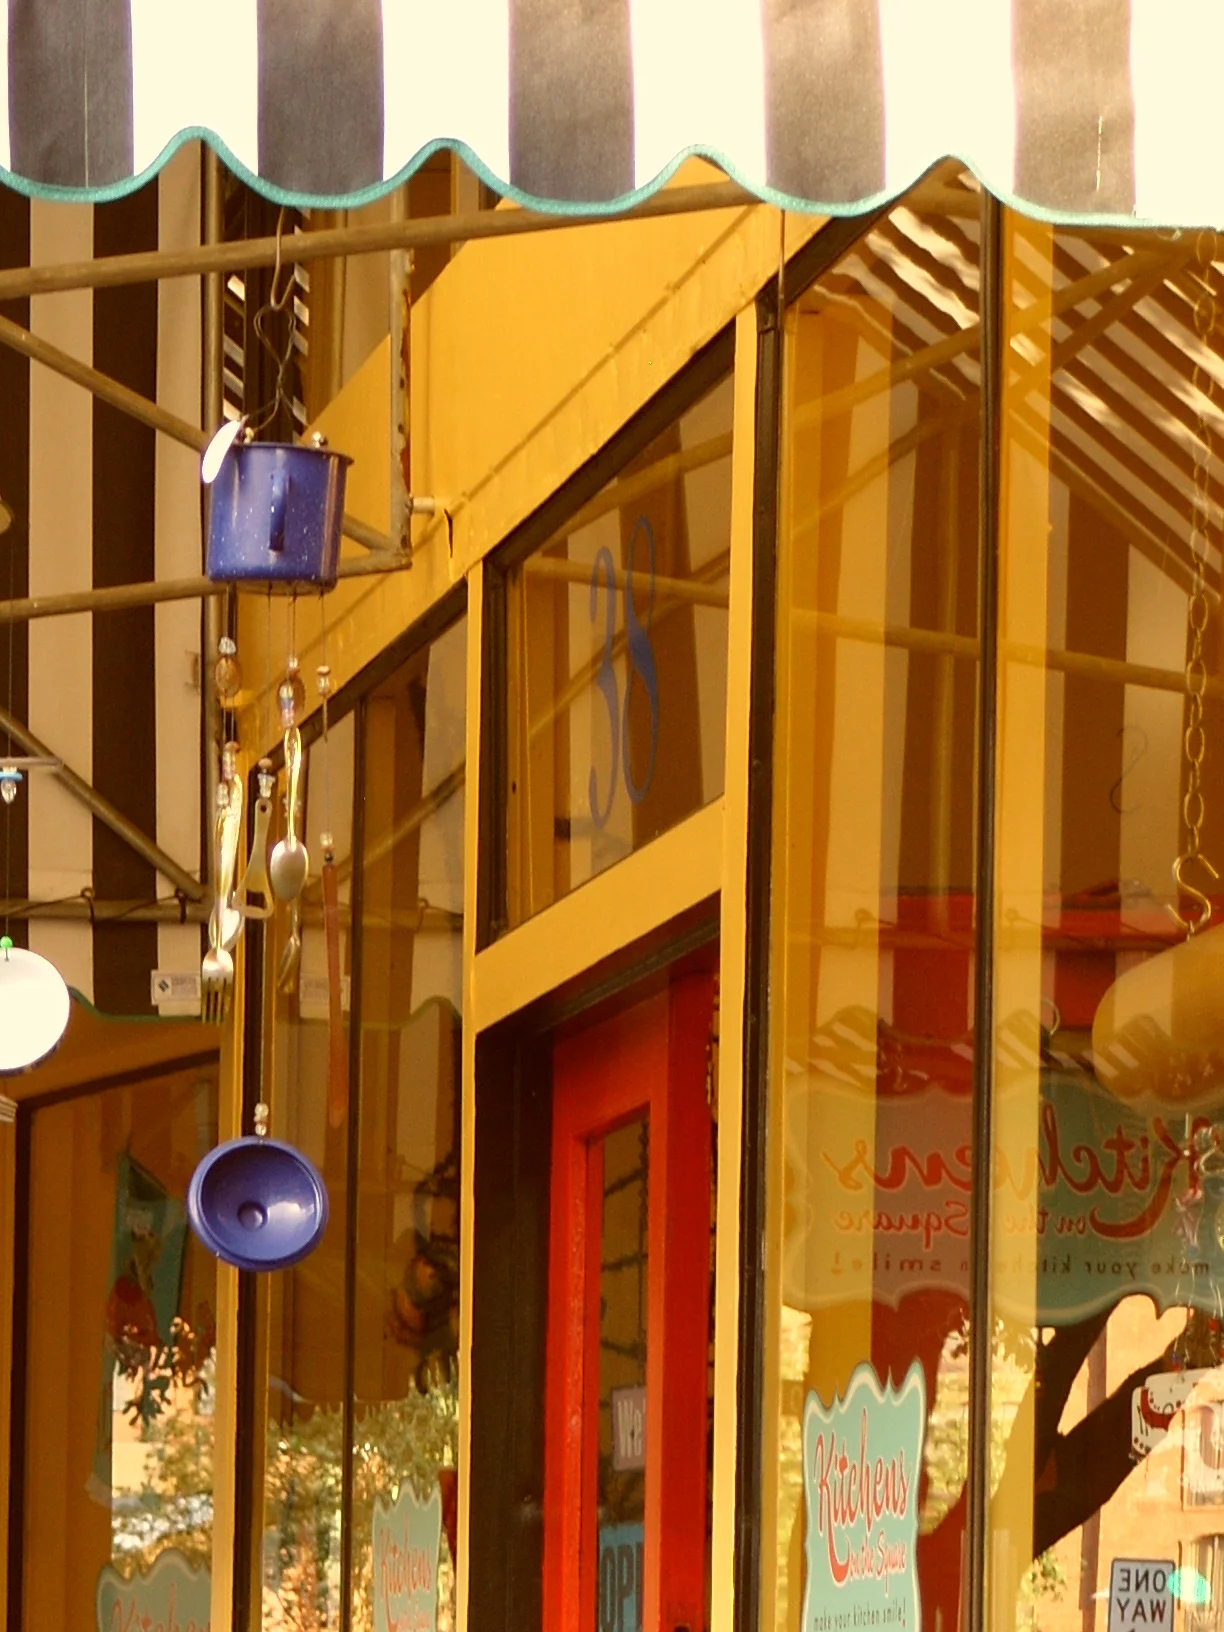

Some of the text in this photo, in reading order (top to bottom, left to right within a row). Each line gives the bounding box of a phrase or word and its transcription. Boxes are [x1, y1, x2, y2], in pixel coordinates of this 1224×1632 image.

[588, 514, 659, 830] 38
[814, 1406, 910, 1587] Kitchens
[814, 1607, 831, 1632] make
[853, 1601, 879, 1627] kitchen
